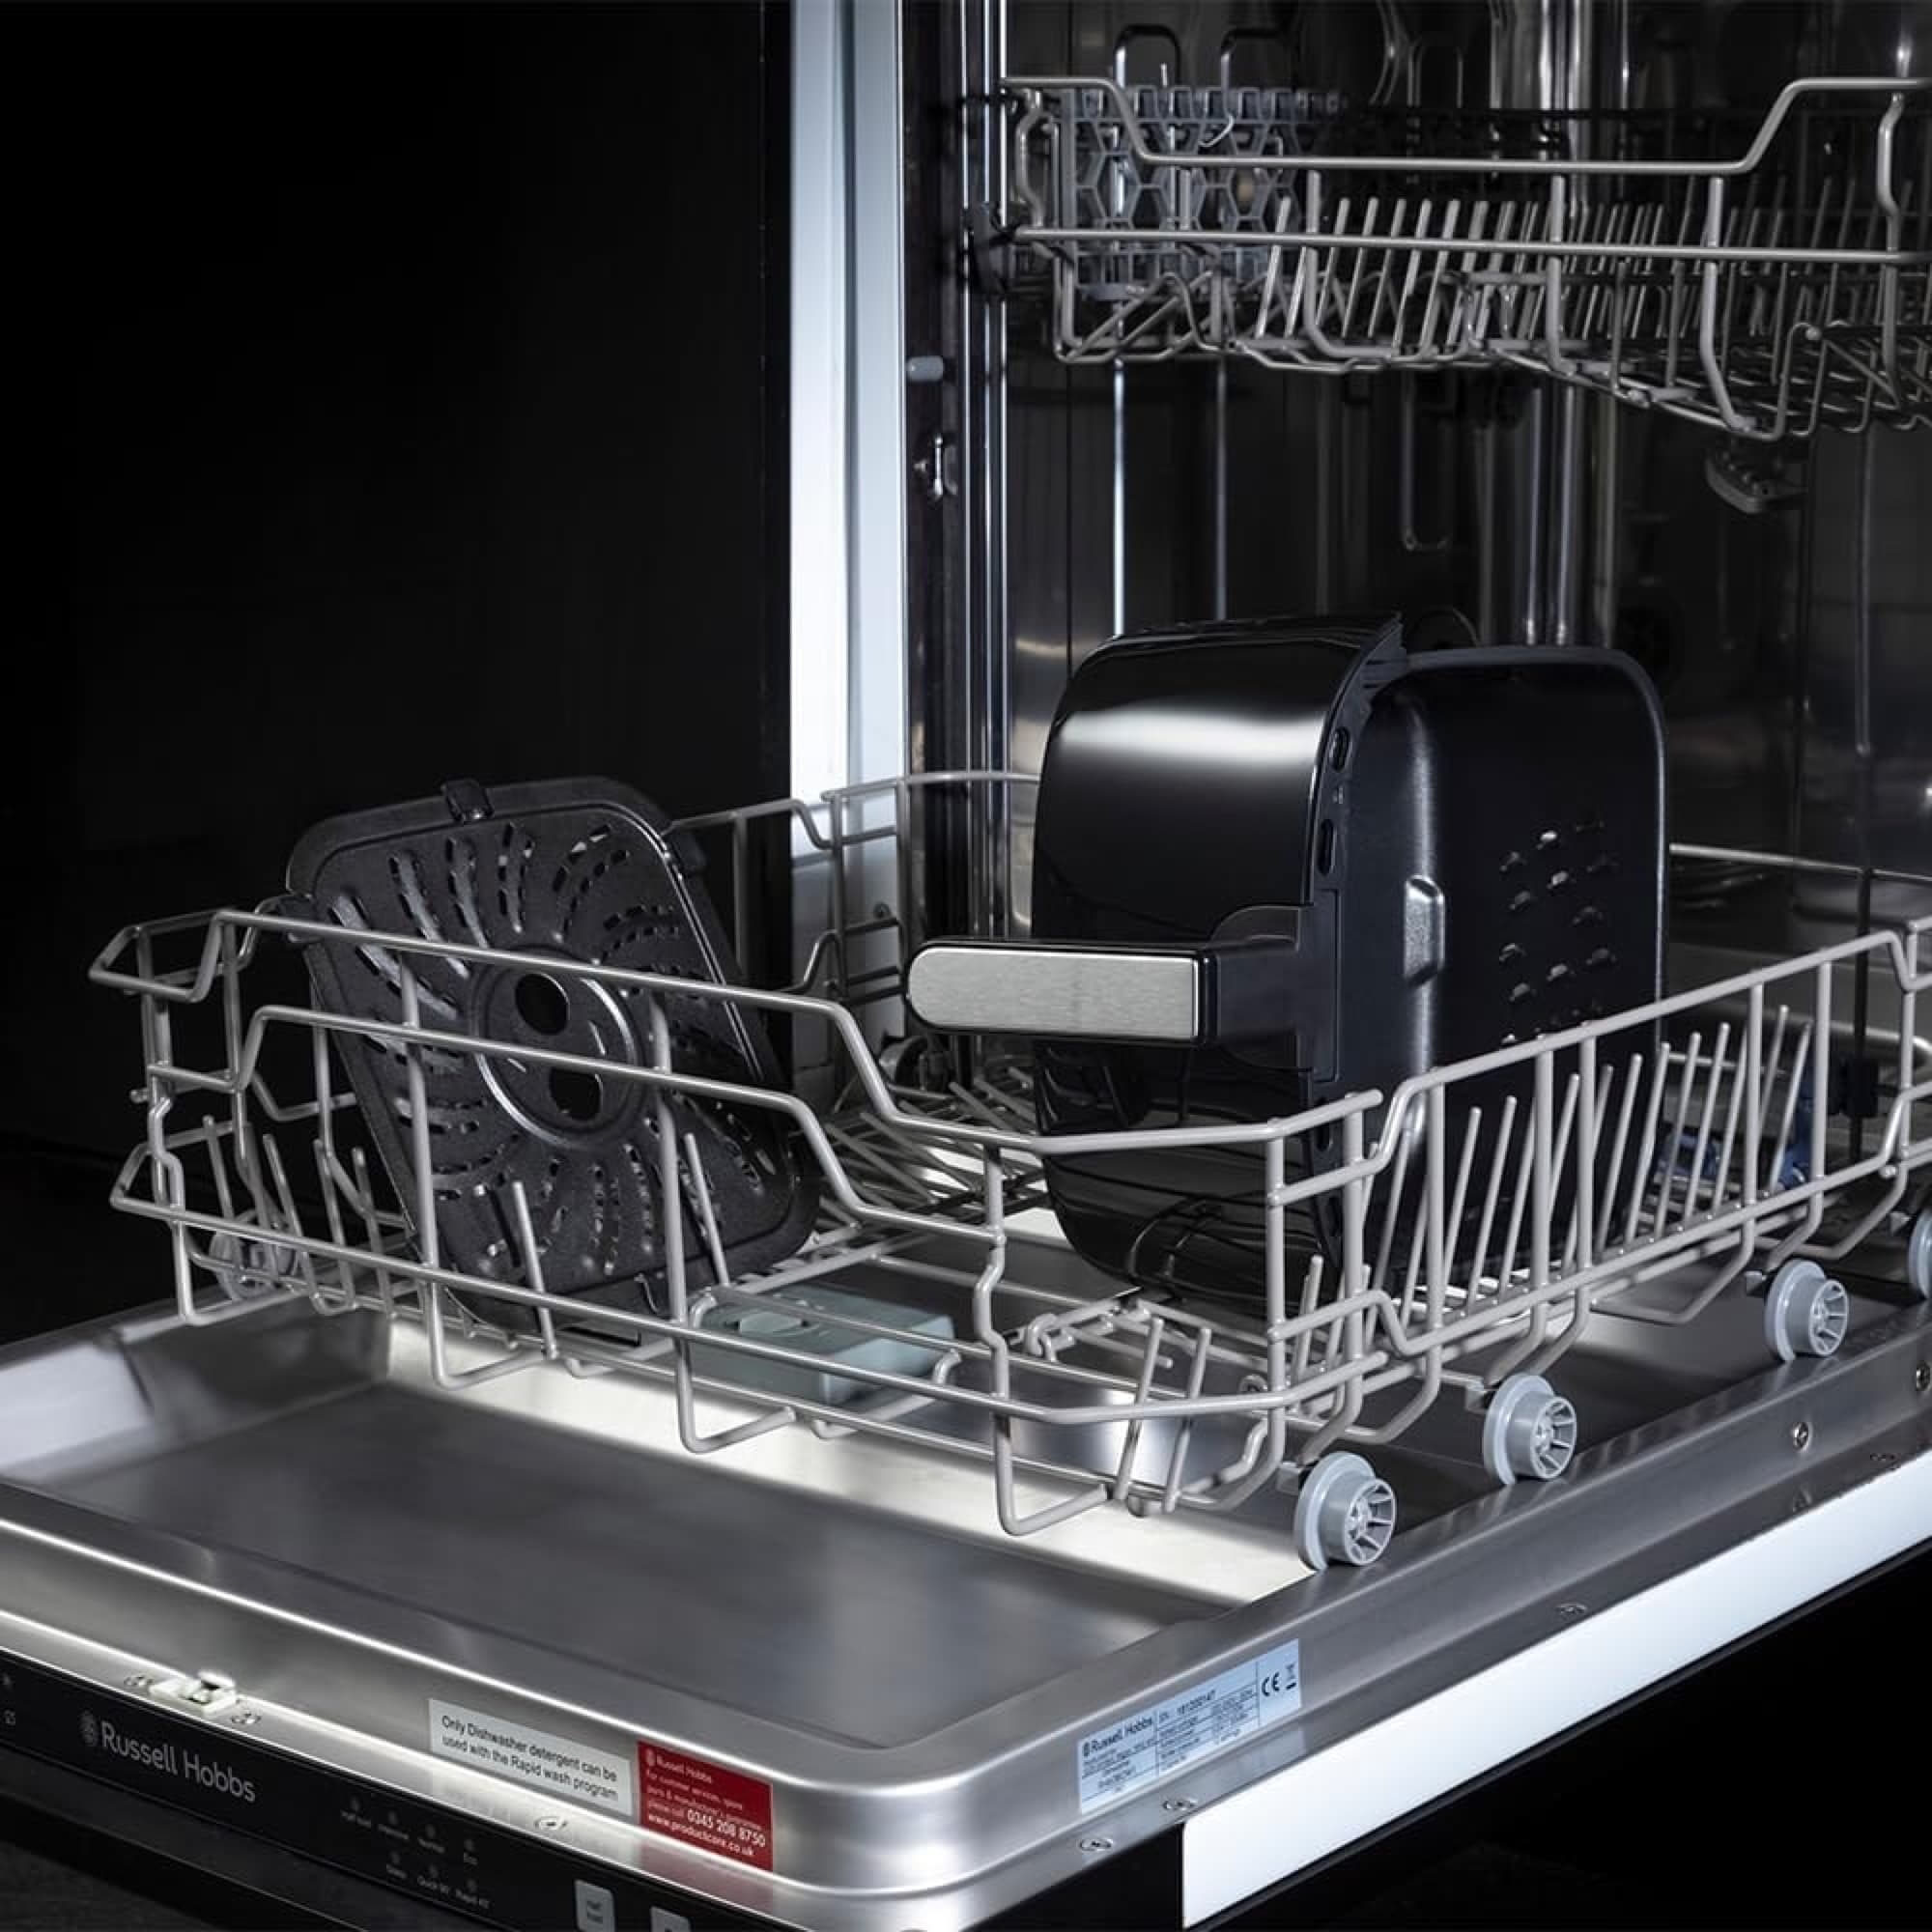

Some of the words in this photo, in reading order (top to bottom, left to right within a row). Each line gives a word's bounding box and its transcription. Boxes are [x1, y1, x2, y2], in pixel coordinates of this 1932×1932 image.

[101, 1719, 178, 1776] Russell
[184, 1748, 256, 1804] Hobbs
[441, 1715, 466, 1736] Only
[468, 1722, 527, 1752] Dishwasher
[528, 1745, 581, 1770] detergent
[582, 1761, 602, 1777] can
[603, 1766, 617, 1782] be
[441, 1735, 468, 1752] used
[469, 1741, 491, 1759] with
[493, 1748, 509, 1766] the
[511, 1755, 542, 1776] Rapid
[543, 1767, 572, 1786] wash
[573, 1776, 619, 1799] program
